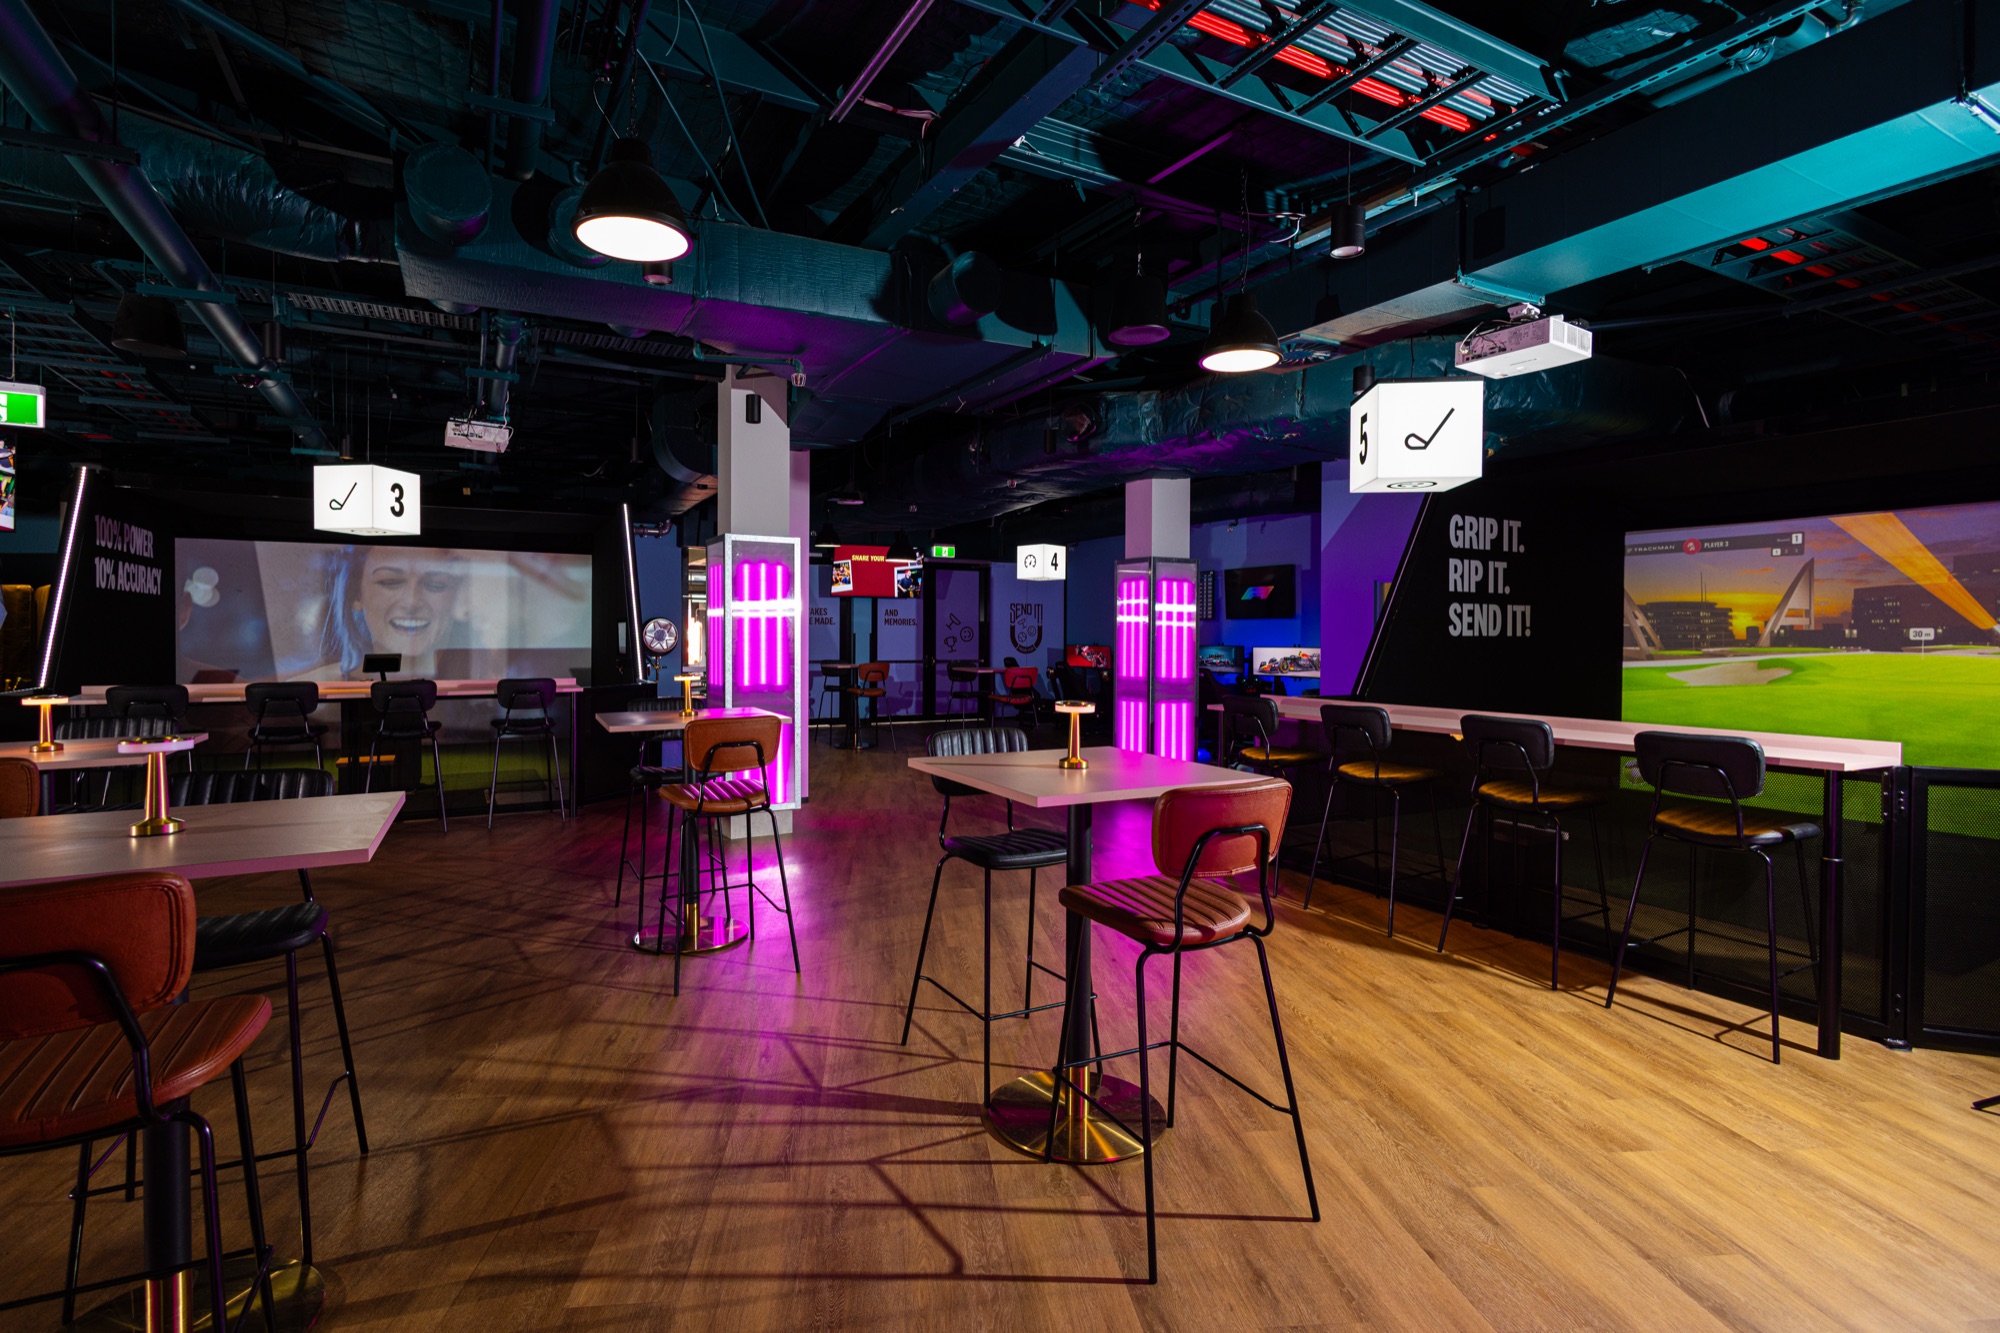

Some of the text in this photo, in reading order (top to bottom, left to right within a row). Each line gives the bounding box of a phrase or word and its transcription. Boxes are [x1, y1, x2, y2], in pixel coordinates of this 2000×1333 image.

[1359, 412, 1368, 466] 5
[390, 482, 405, 518] 3
[95, 514, 154, 559] 100% POWER
[1449, 513, 1525, 553] GRIP IT.
[1794, 534, 1799, 542] 1
[1633, 544, 1675, 553] TRACKMAN
[1703, 541, 1724, 549] PLAYER
[851, 554, 869, 562] SHARE
[1051, 552, 1059, 571] 4
[95, 556, 162, 596] 10% ACCURACY
[1449, 558, 1511, 595] RIP IT.
[814, 616, 836, 625] MADE.
[884, 608, 899, 617] AND
[884, 617, 918, 626] MEMORIES.
[1010, 602, 1033, 624] SEND
[1448, 602, 1531, 638] SEND IT!
[1912, 630, 1923, 638] 30
